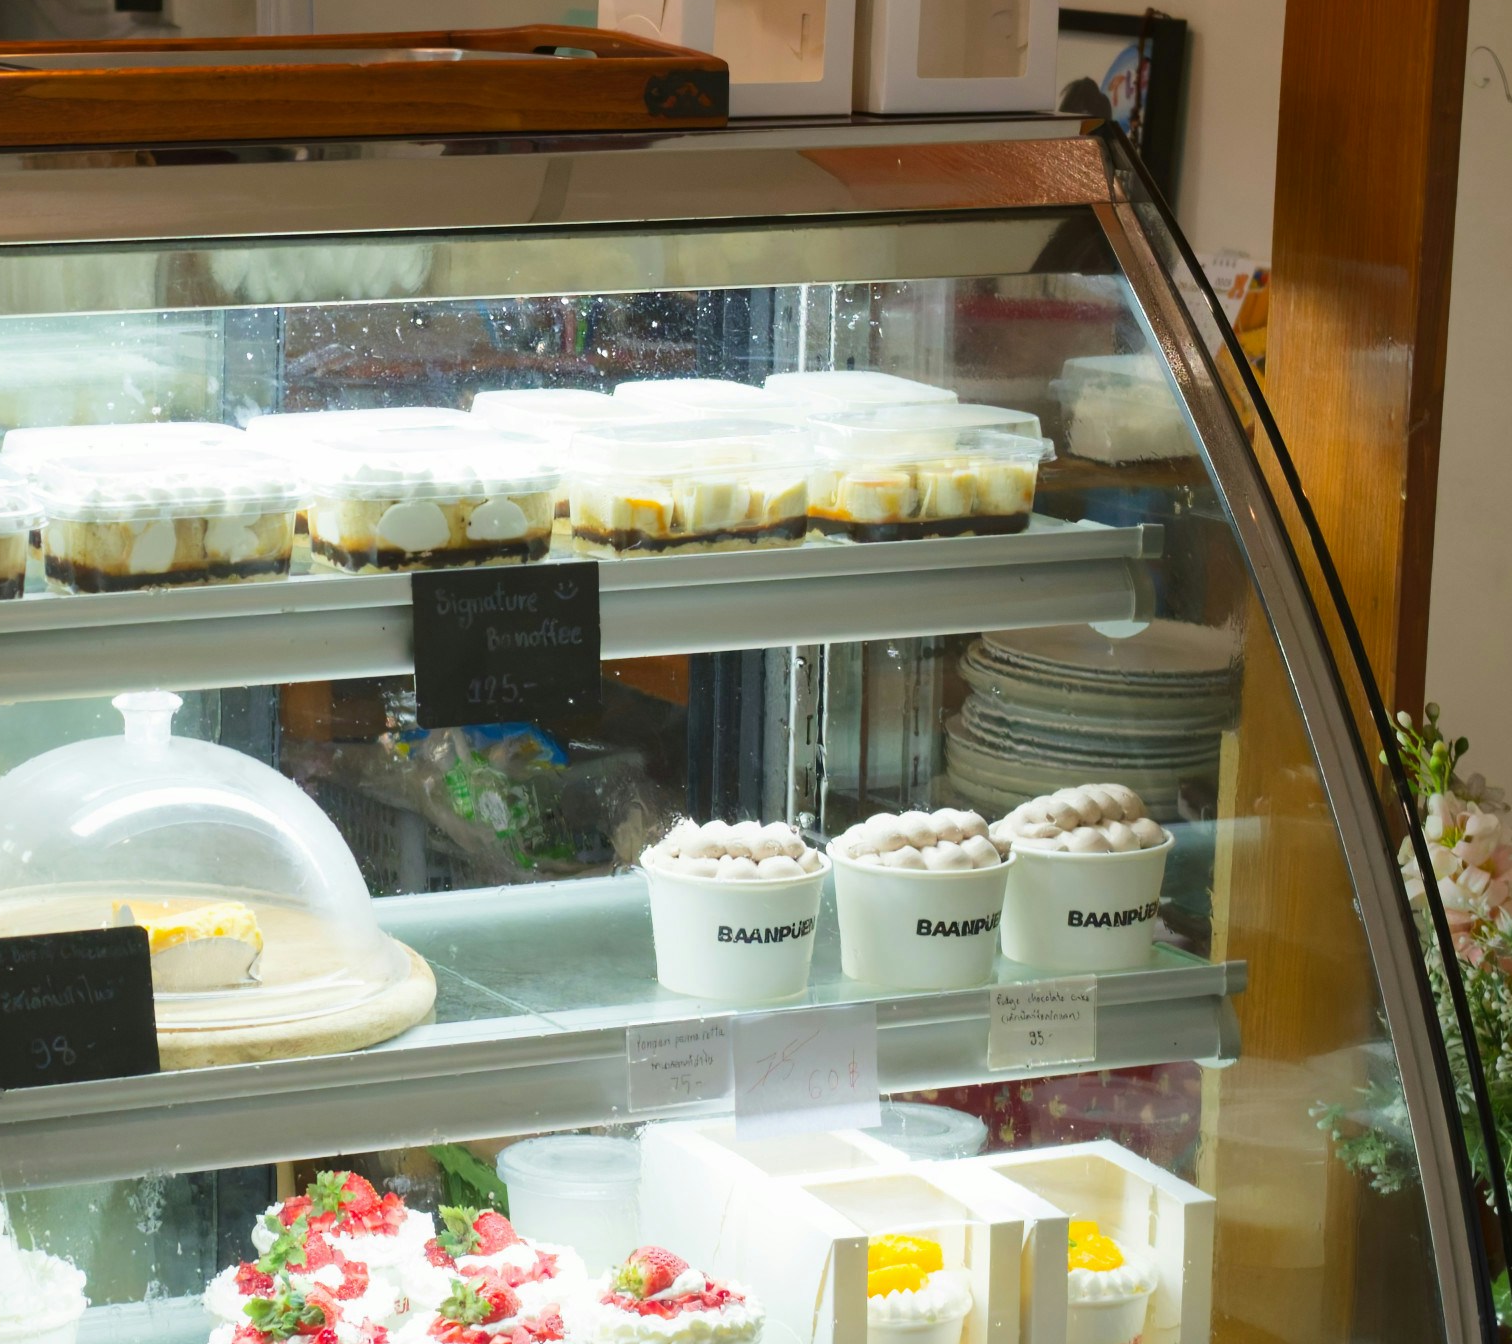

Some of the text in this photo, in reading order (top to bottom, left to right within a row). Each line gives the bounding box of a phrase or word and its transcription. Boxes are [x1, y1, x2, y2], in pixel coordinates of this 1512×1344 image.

[435, 581, 537, 630] Signature
[486, 618, 582, 652] Banoffee
[1028, 992, 1064, 1003] chocolate
